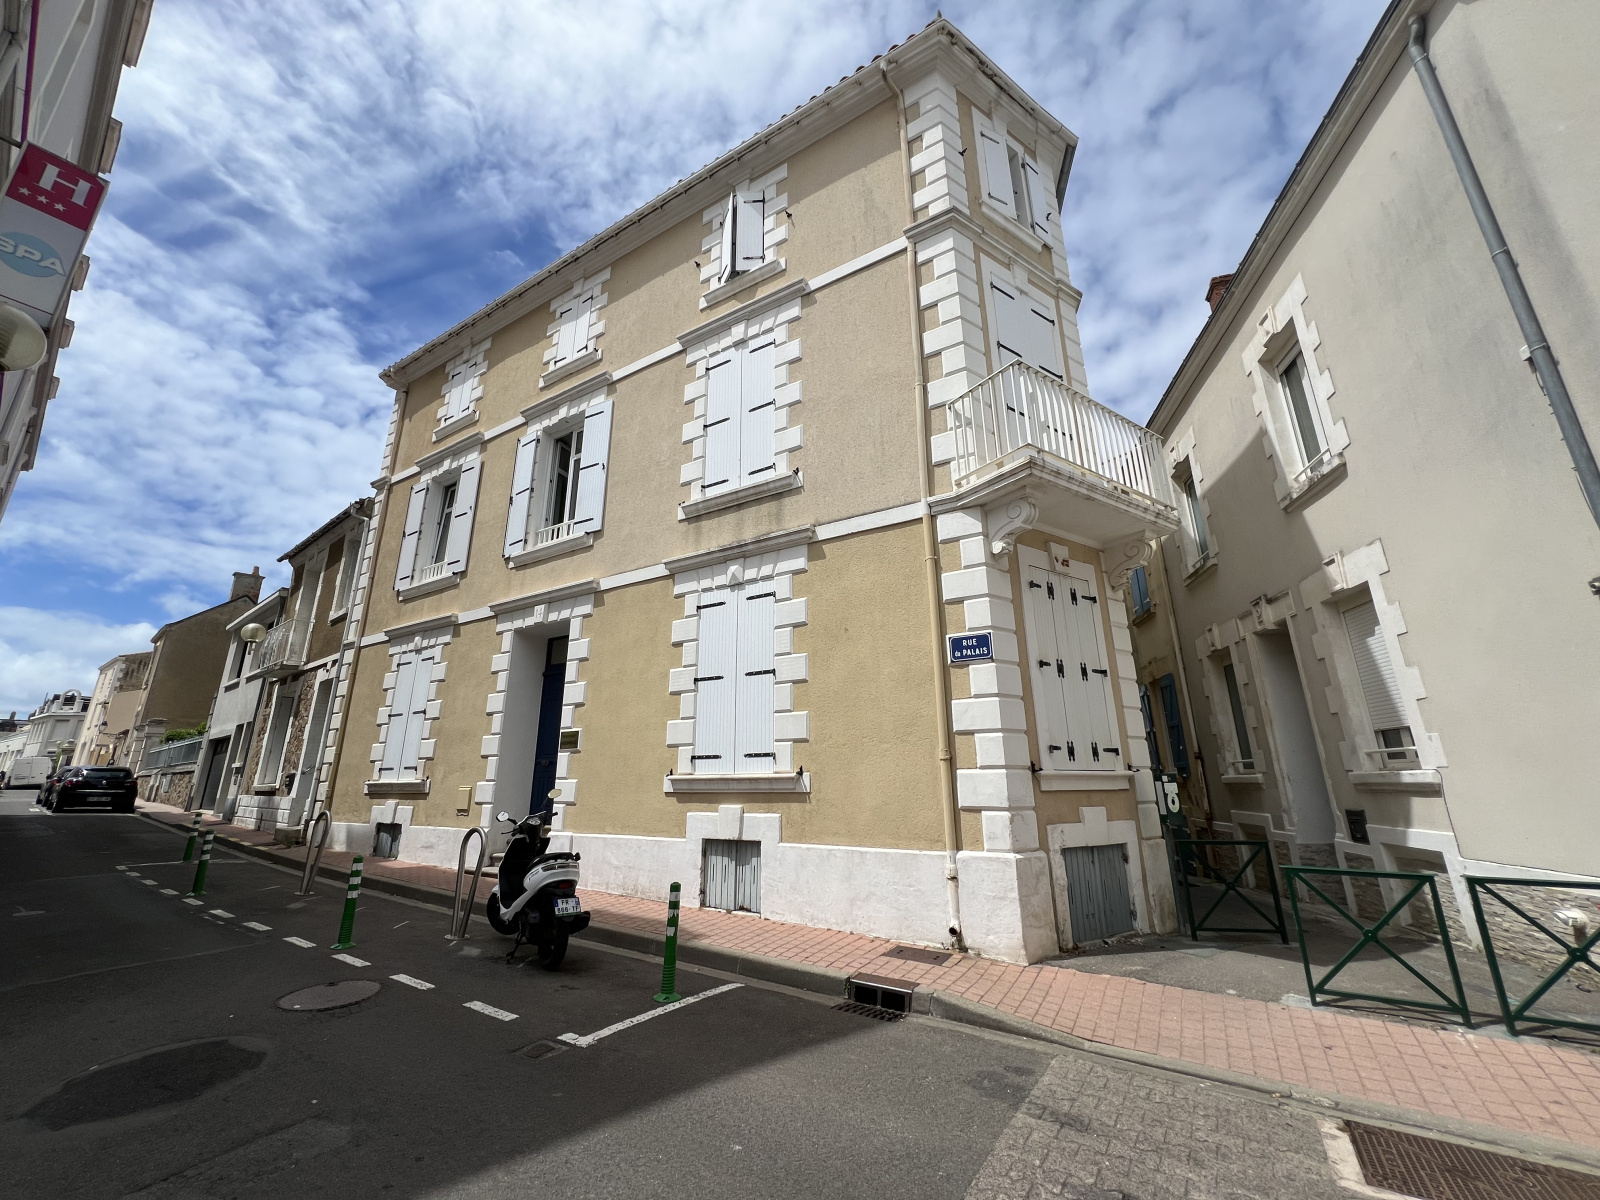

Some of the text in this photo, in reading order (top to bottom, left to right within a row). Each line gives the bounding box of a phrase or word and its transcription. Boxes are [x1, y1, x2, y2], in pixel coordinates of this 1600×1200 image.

[33, 160, 96, 209] H
[0, 235, 66, 276] SPA
[962, 638, 977, 647] RUE
[962, 647, 988, 657] PALAIS
